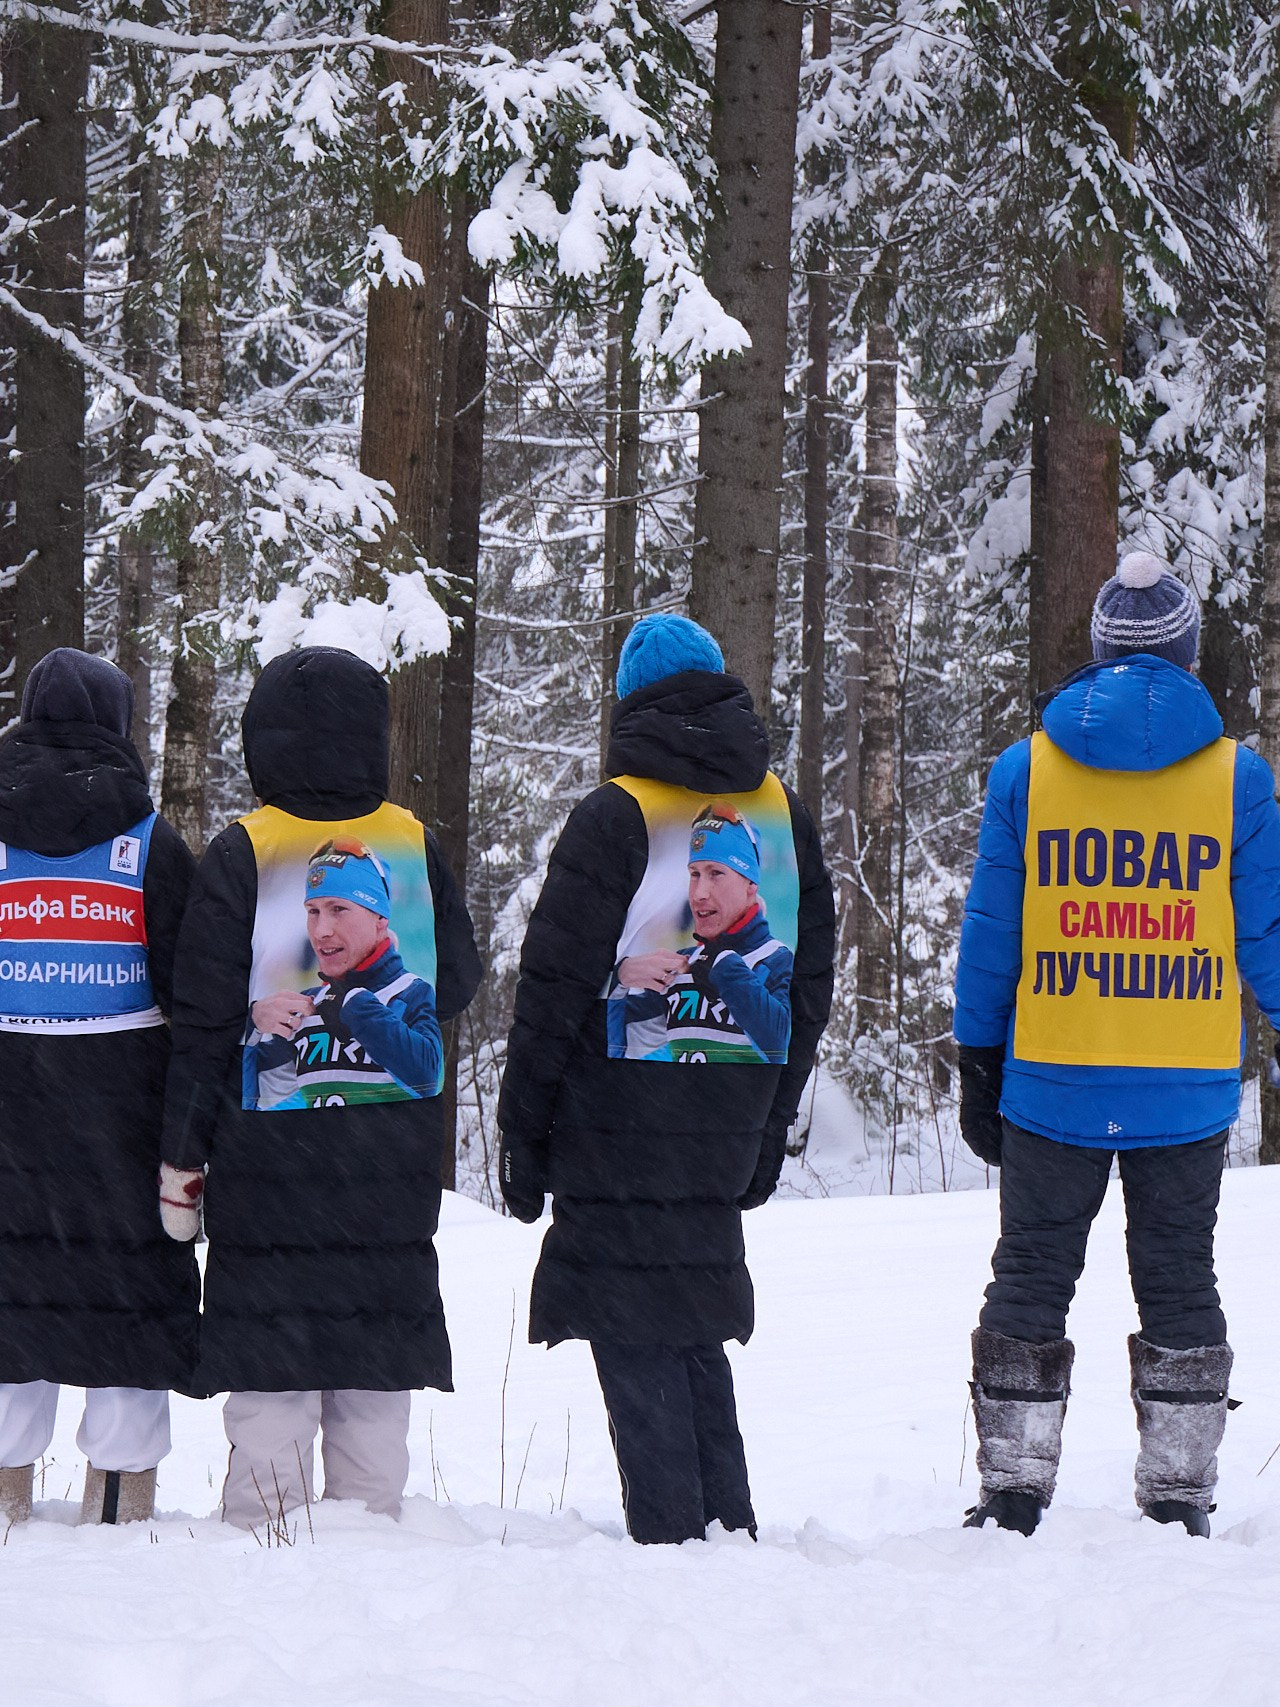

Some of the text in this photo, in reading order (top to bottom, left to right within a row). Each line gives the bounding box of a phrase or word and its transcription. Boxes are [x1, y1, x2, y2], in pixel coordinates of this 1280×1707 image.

[1037, 827, 1221, 891] ПОВАР
[70, 894, 136, 927] Банк
[1059, 899, 1196, 941] САМЫЙ
[1033, 947, 1223, 1001] ЛУЧШИЙ!
